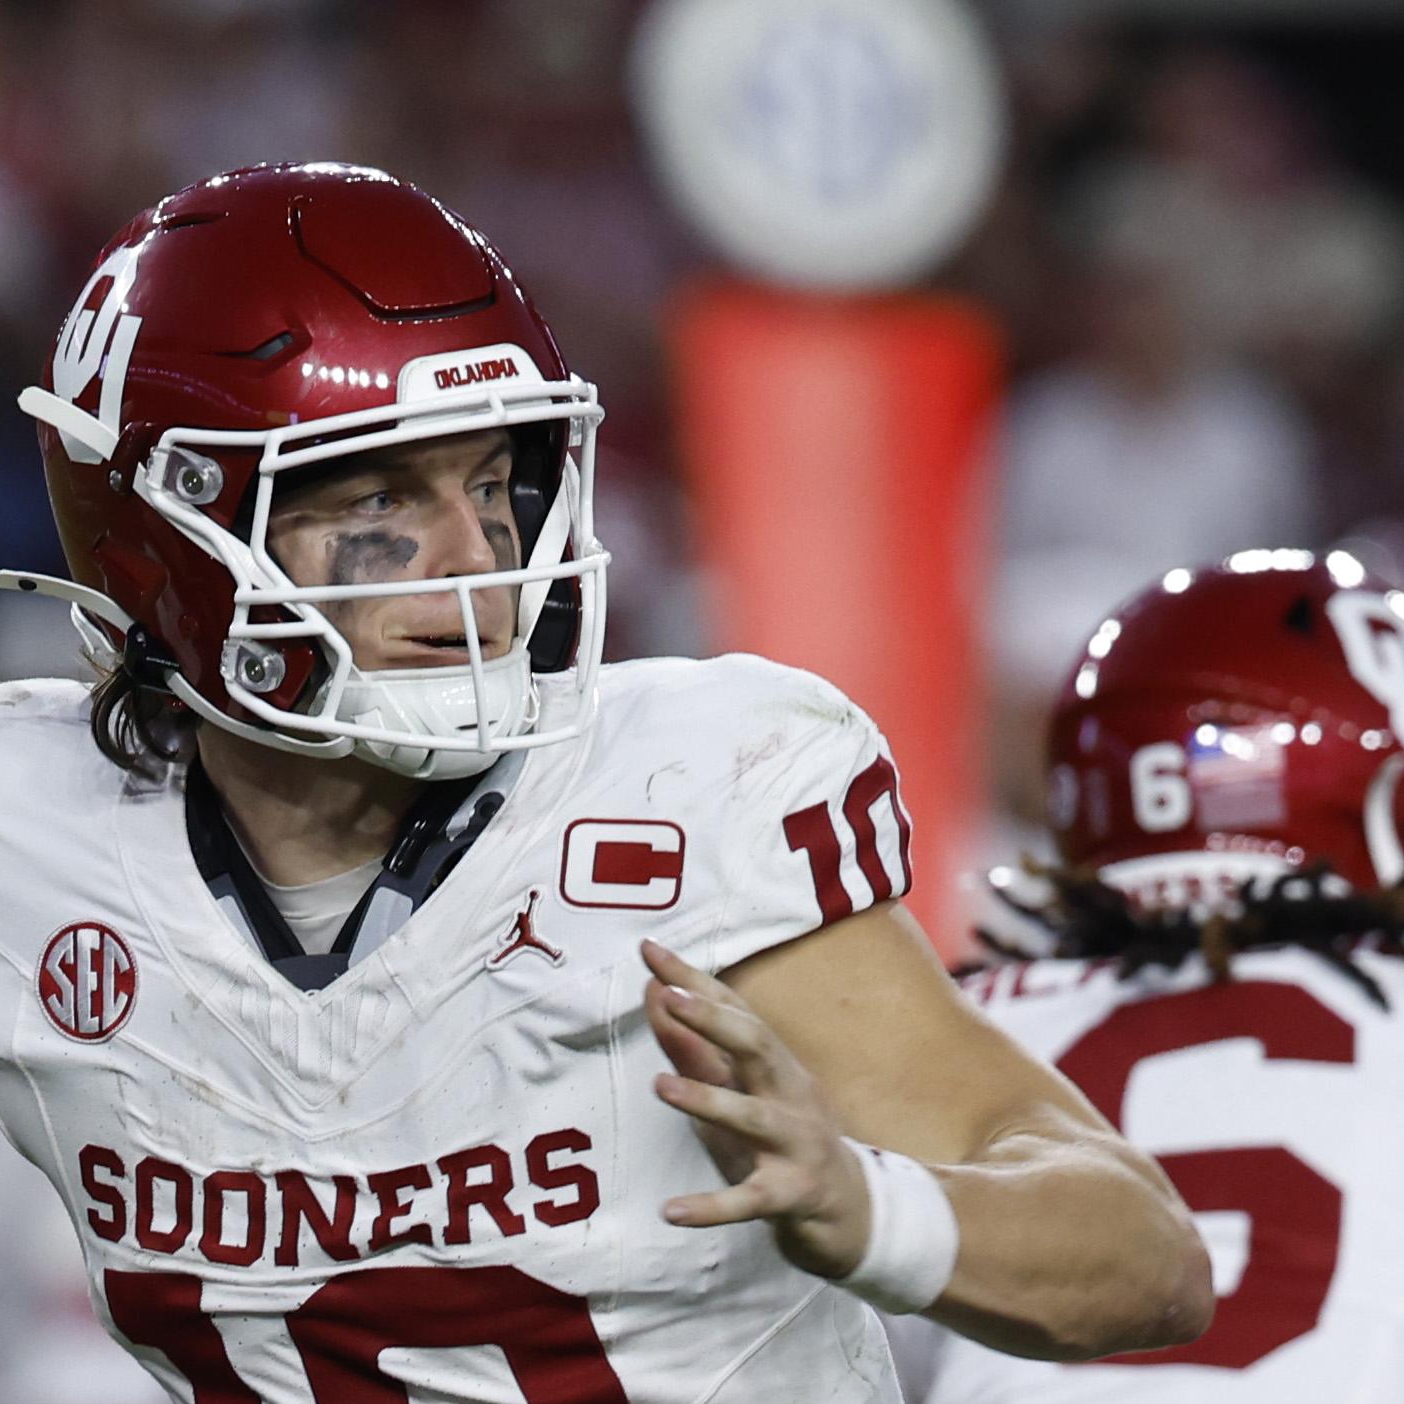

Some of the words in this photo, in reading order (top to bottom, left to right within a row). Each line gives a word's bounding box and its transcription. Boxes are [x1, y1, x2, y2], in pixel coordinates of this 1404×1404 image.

[434, 357, 519, 389] OKLAHOMA
[1130, 743, 1190, 832] 6
[558, 818, 686, 911] C
[782, 753, 912, 929] 10
[44, 928, 131, 1034] SEC
[79, 1127, 601, 1268] SOONERS
